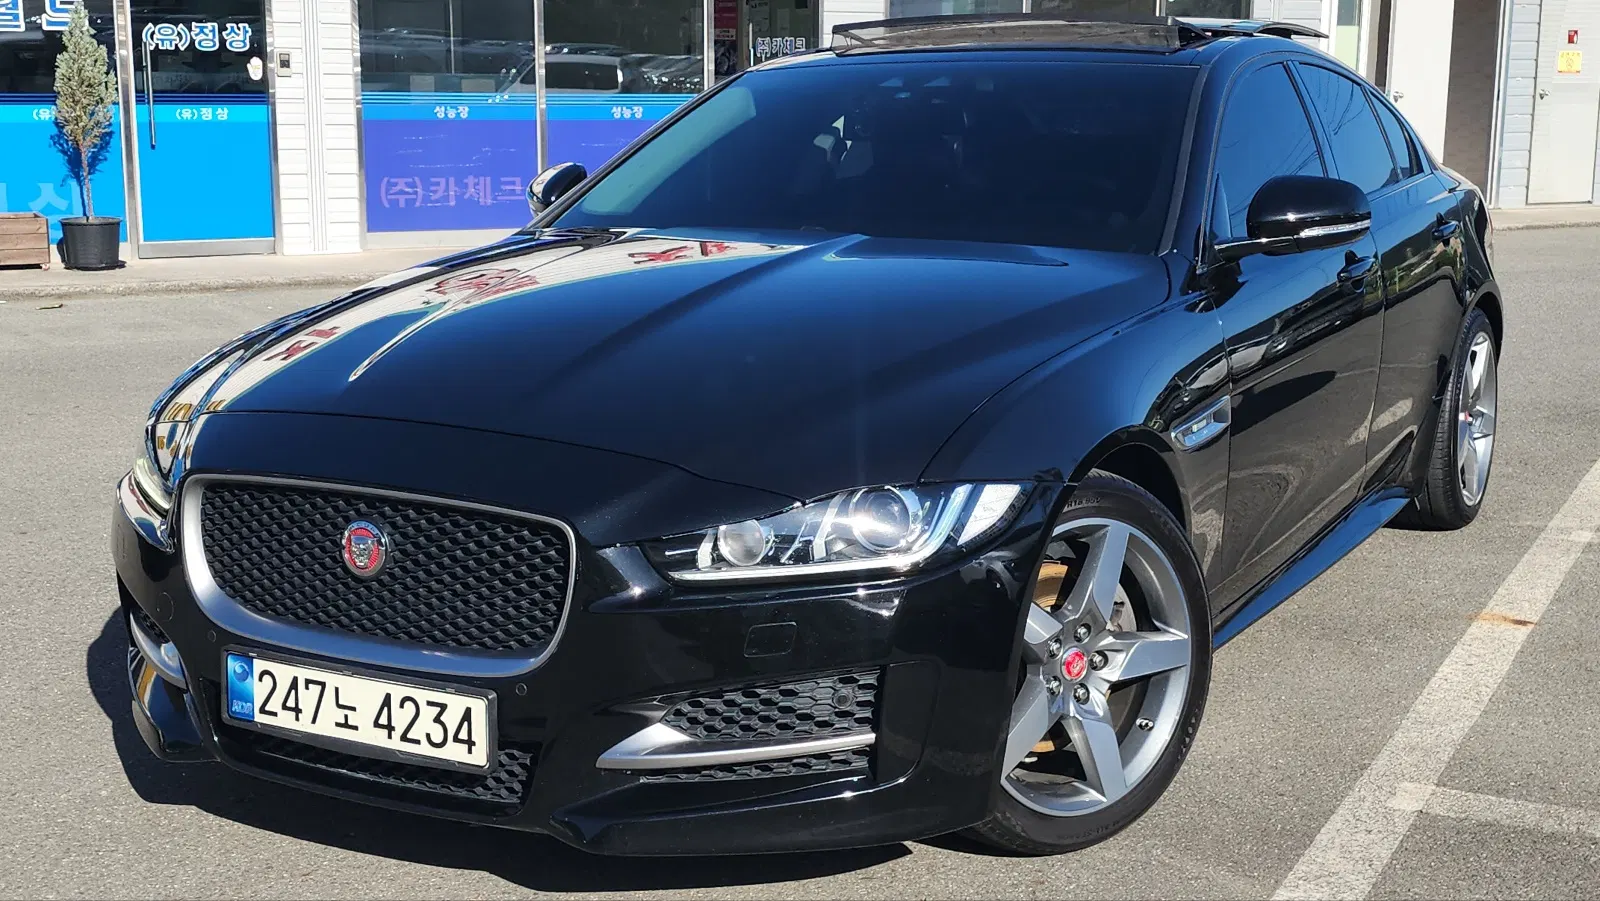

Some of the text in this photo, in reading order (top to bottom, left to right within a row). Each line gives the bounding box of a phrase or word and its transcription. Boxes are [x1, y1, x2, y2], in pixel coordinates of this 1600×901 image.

[433, 105, 470, 119] 성능장
[610, 105, 644, 119] 성능장
[258, 669, 476, 755] 247노 4234
